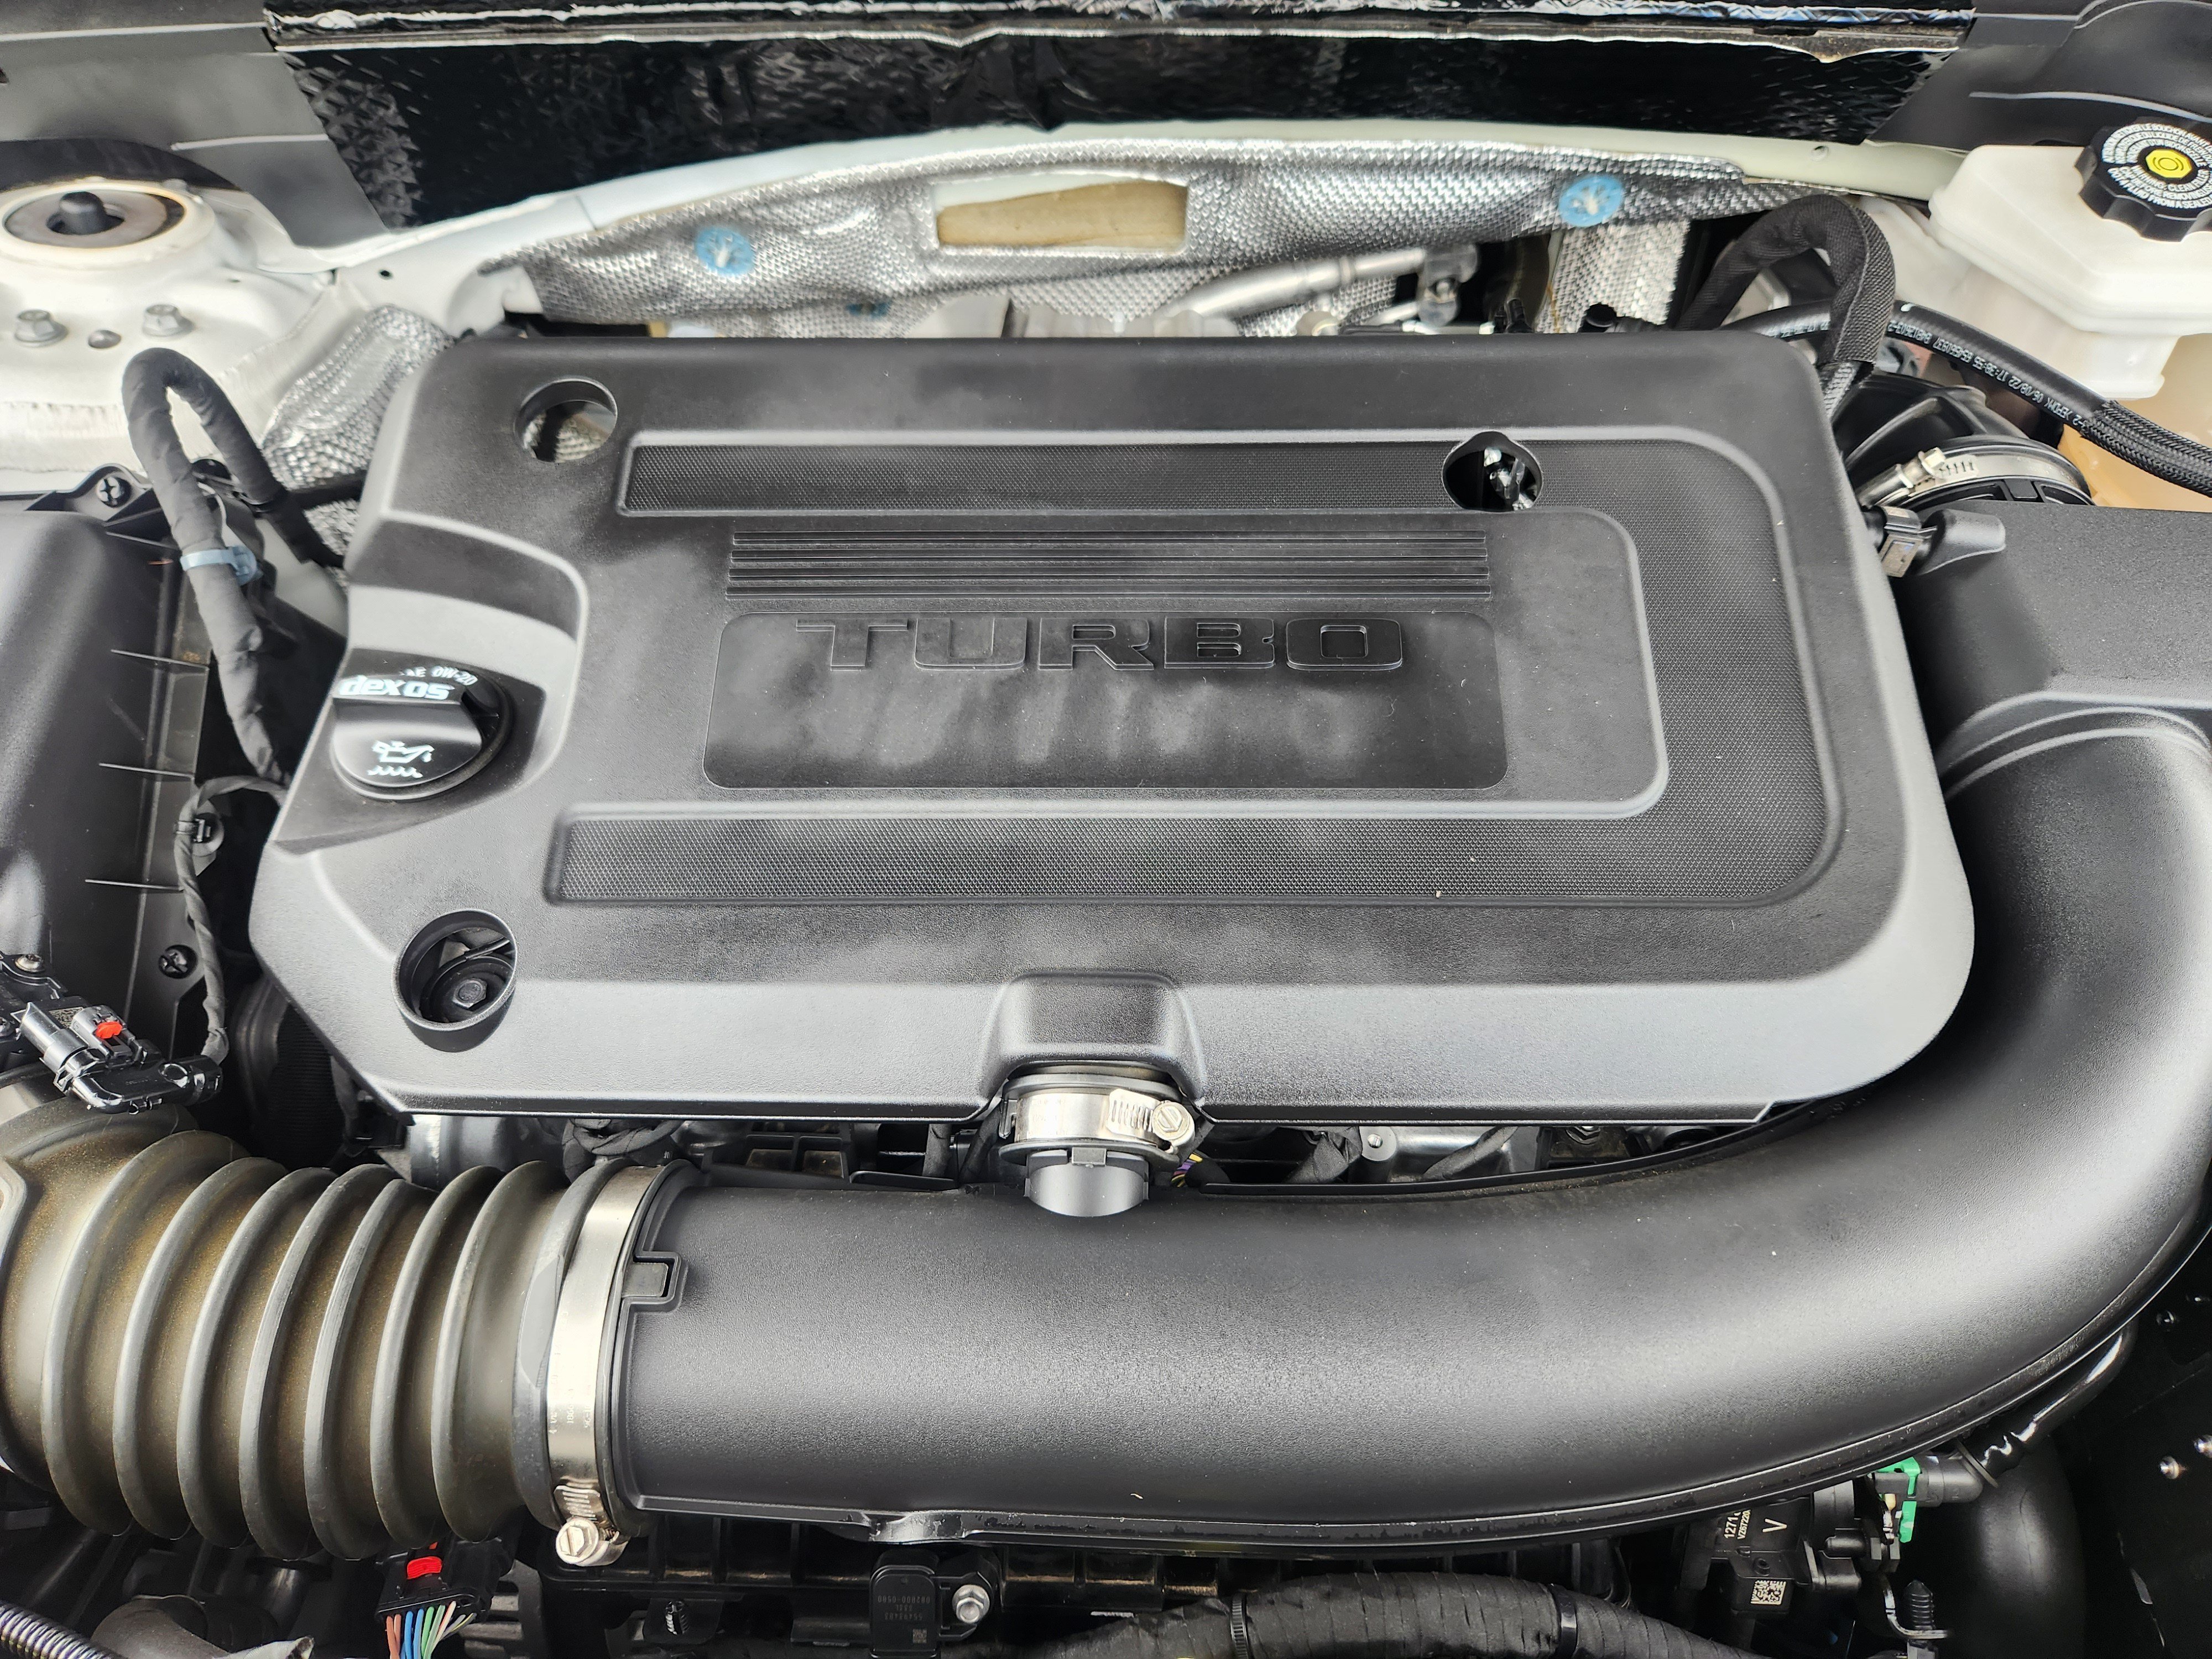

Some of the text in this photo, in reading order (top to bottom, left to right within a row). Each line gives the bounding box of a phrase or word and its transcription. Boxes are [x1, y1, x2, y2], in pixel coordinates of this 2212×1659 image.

[2184, 132, 2211, 147] AVANT
[795, 617, 1404, 671] TURBO
[339, 674, 456, 701] dexos
[1724, 1511, 1742, 1539] 1271
[1762, 1518, 1787, 1533] V
